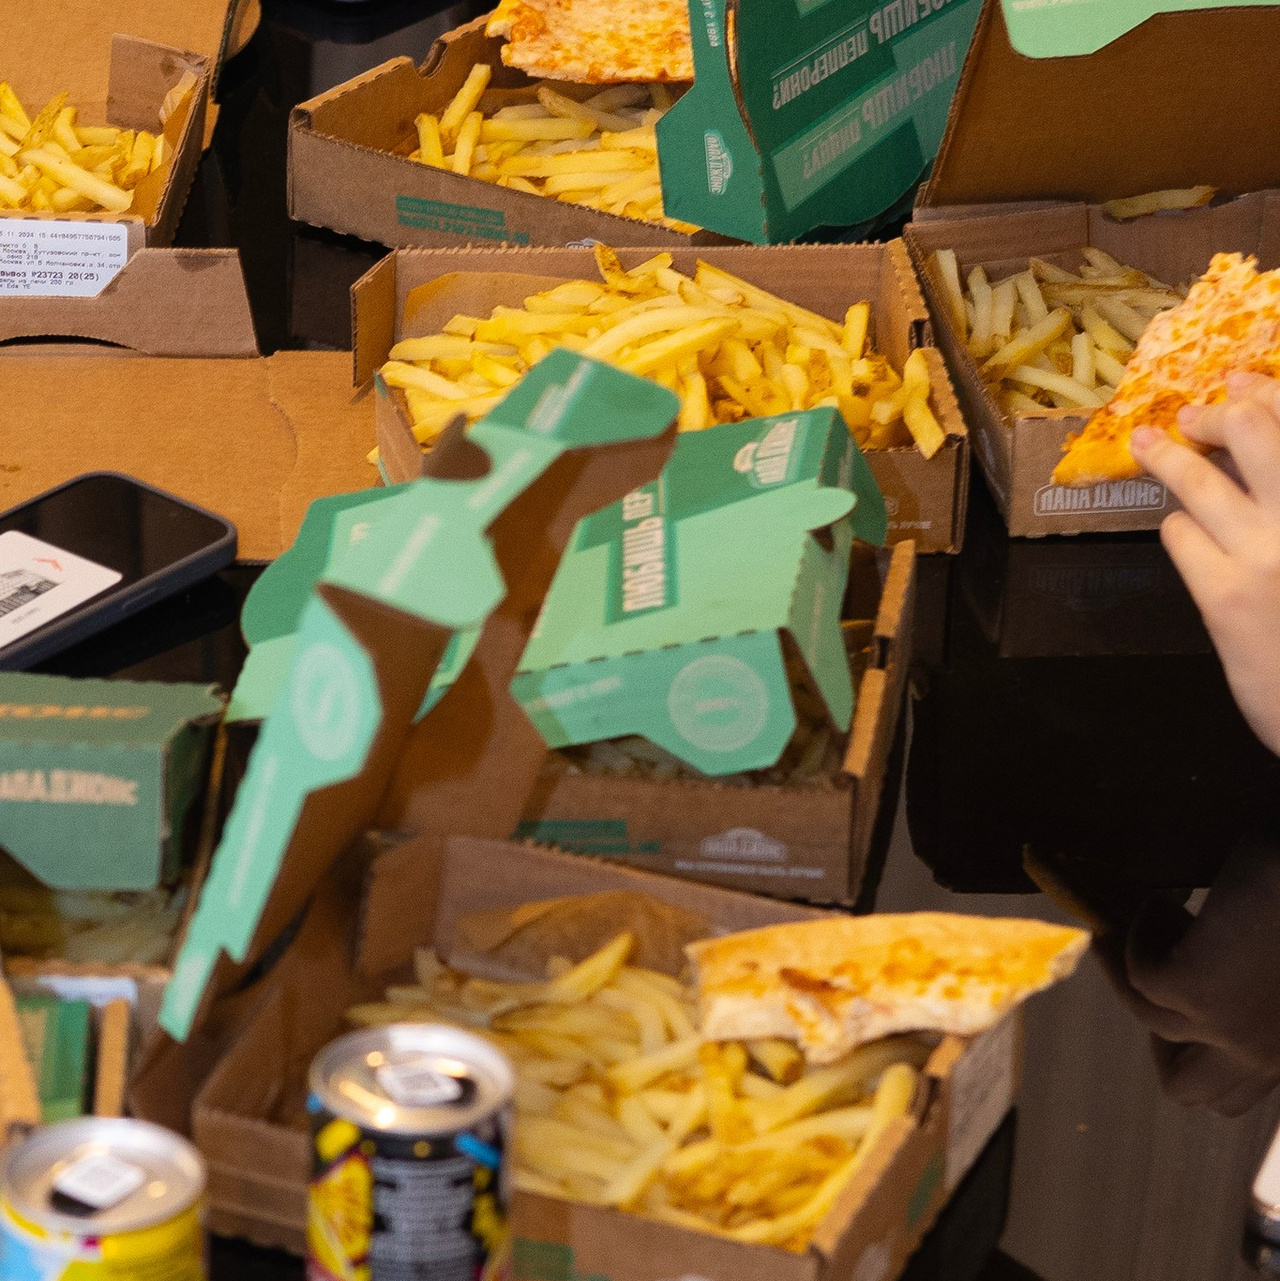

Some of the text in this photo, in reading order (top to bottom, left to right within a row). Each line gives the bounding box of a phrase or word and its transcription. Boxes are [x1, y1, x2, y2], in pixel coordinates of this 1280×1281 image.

[773, 30, 870, 111] ПЕППЕРОНИ?
[803, 44, 957, 178] ЛЮБИШЬ ПИЦЦУ?
[1040, 479, 1161, 512] ПАПА ДЖОНС
[622, 515, 666, 612] ЛЮБИШЬ
